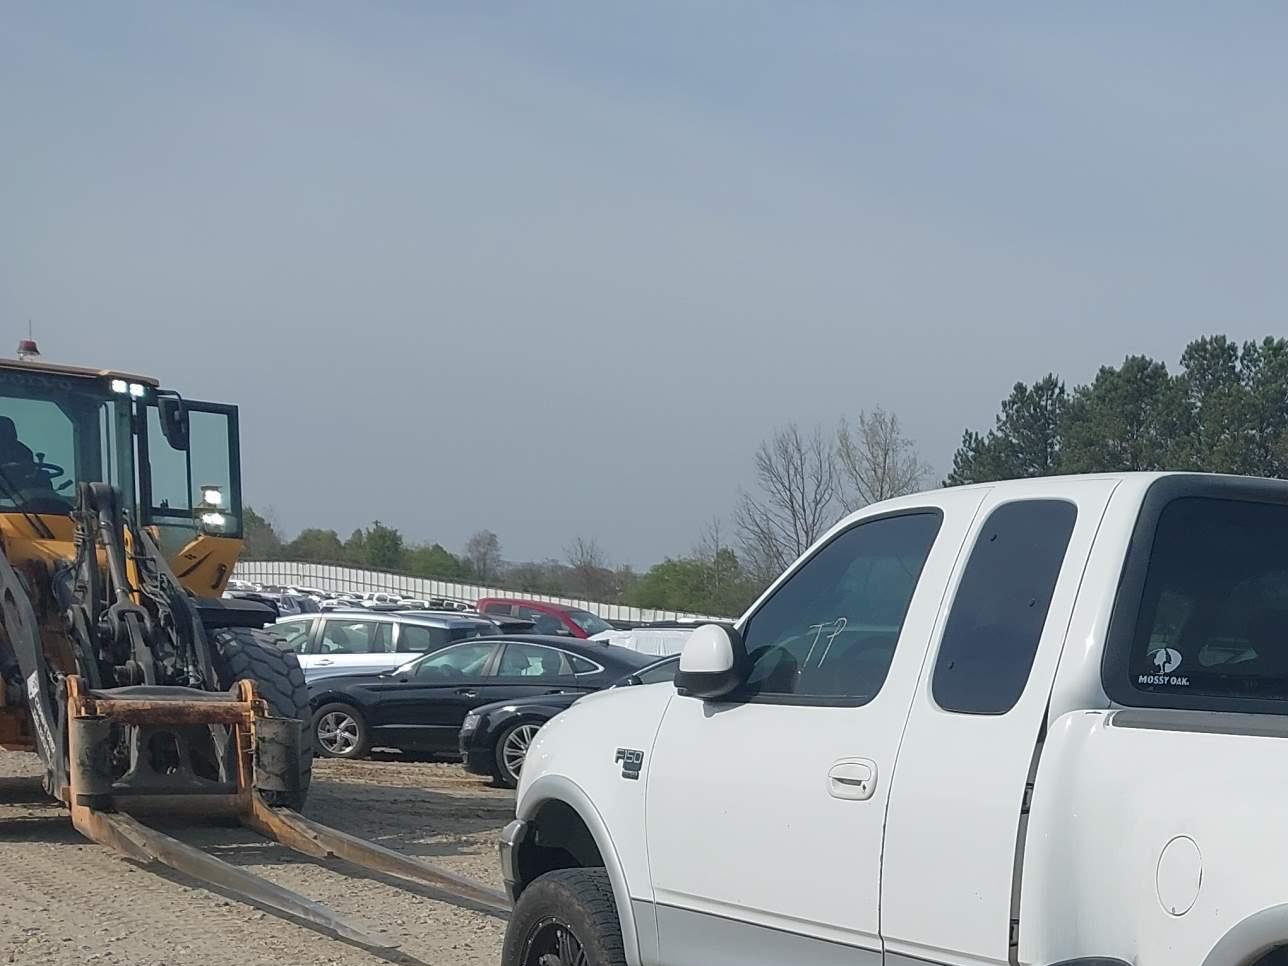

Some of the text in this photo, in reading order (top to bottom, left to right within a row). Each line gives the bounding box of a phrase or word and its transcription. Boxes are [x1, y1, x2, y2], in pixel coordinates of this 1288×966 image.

[1138, 675, 1188, 686] MOSSY OAK
[615, 748, 643, 764] F150
